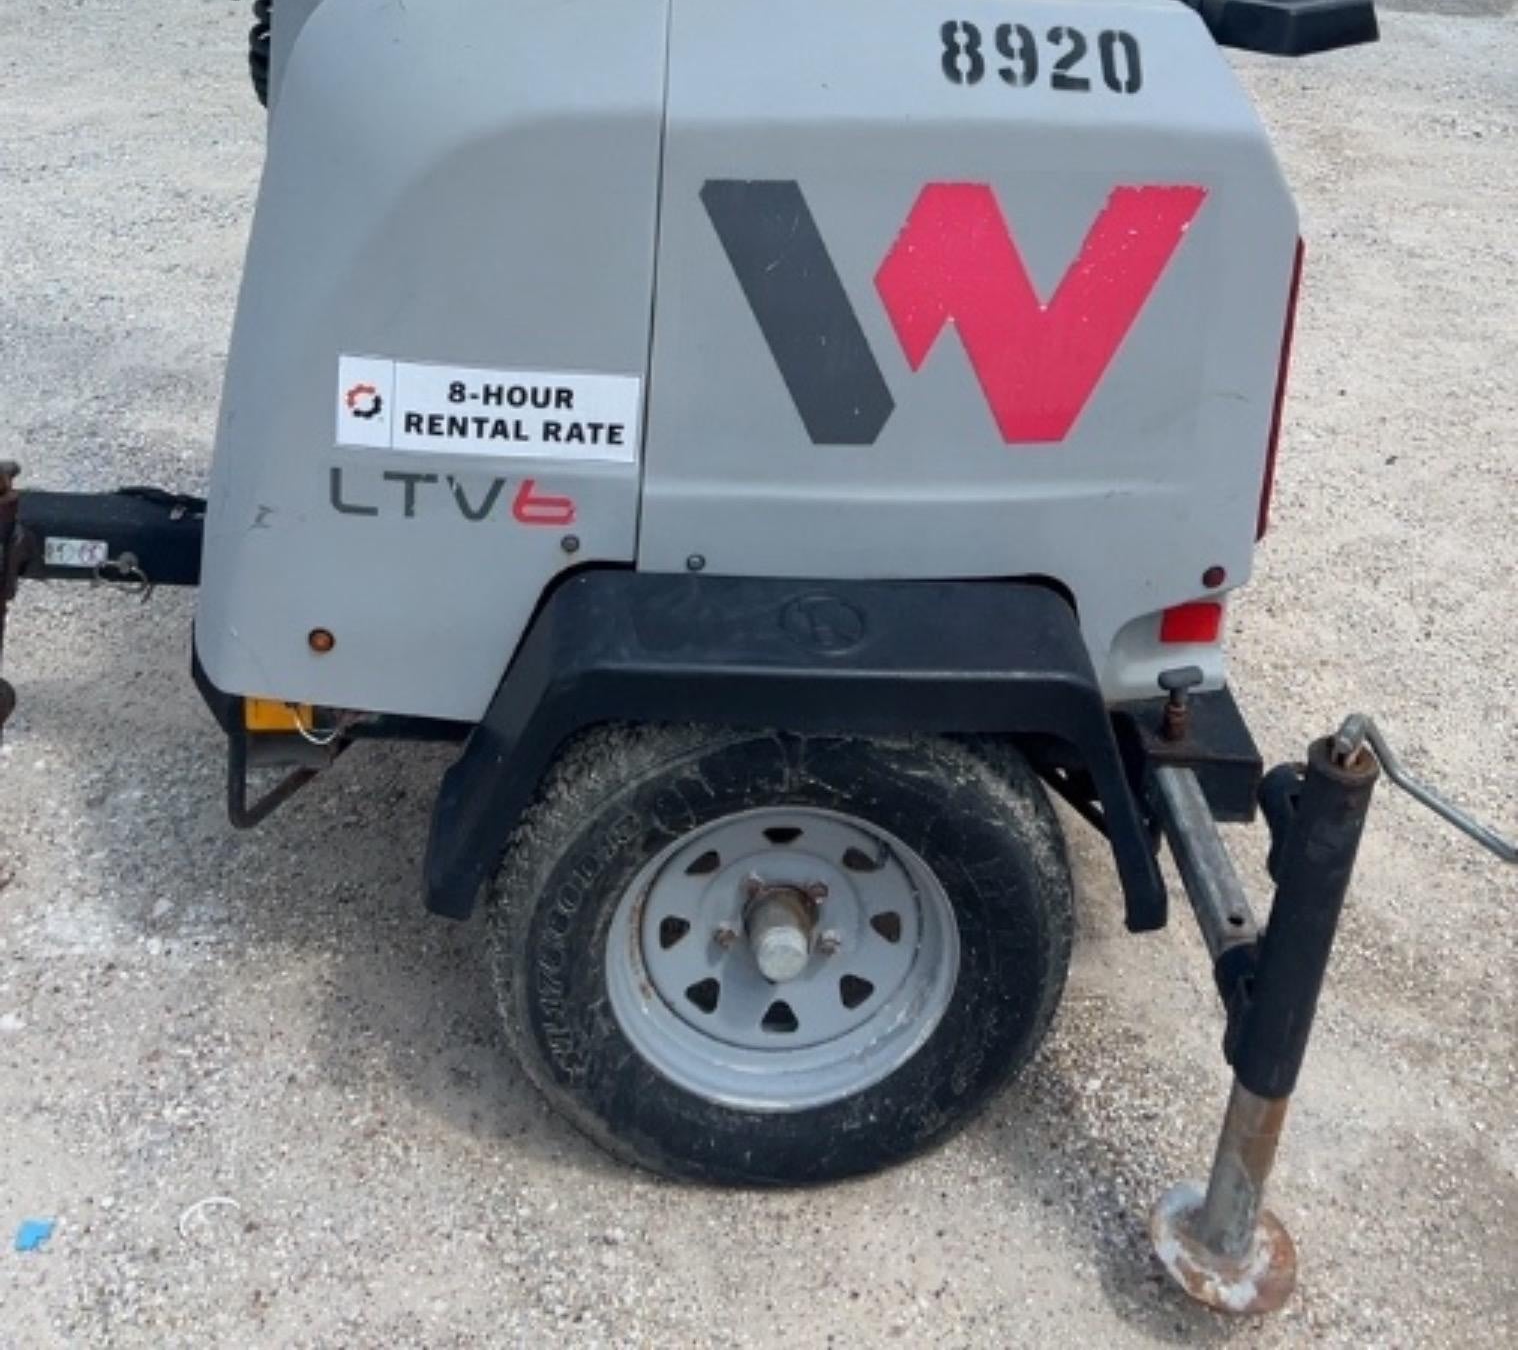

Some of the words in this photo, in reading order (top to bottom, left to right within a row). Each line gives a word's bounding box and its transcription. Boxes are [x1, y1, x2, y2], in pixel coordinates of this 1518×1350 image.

[940, 19, 1143, 94] 8920
[447, 381, 574, 410] 8-HOUR
[404, 412, 530, 442] RENTAL
[541, 420, 625, 446] RATE
[330, 467, 576, 525] LTV6
